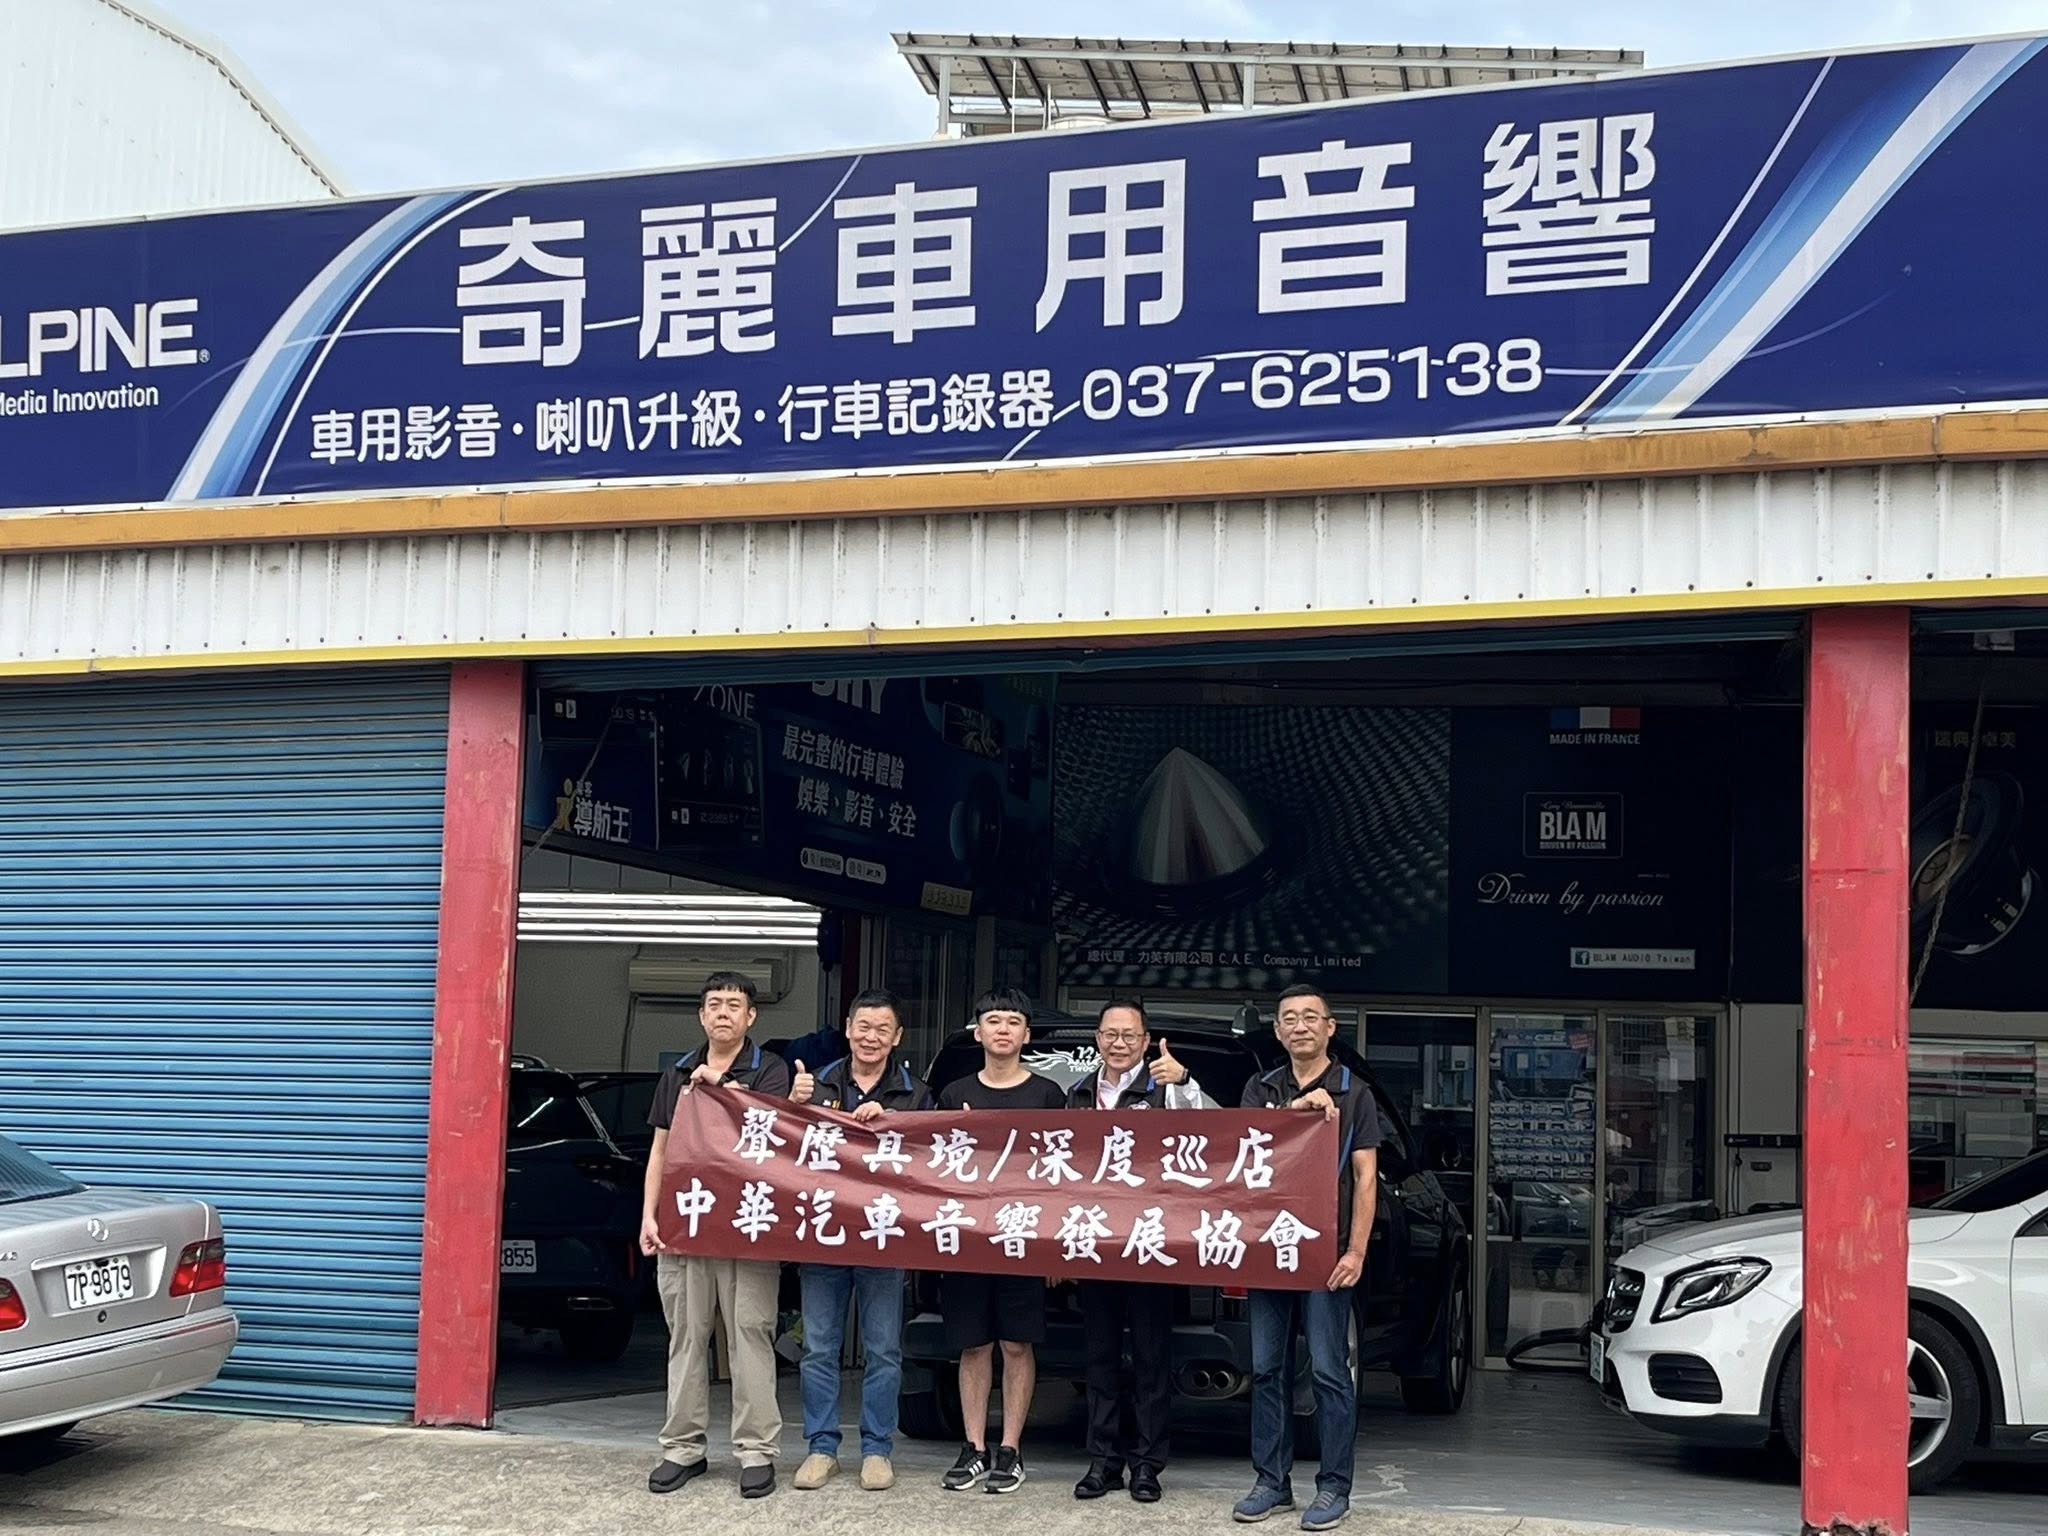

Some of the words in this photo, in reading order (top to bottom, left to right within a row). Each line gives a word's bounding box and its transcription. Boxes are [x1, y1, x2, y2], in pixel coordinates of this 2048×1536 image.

[456, 112, 1657, 367] 奇麗車用音響
[1081, 337, 1543, 421] 037-625138
[0, 389, 47, 416] edia
[53, 383, 159, 413] Innovation
[782, 723, 905, 791] 最完整的行車體驗
[1549, 733, 1581, 745] MADE
[1584, 733, 1597, 745] IN
[1598, 733, 1641, 745] FRANCE
[573, 796, 630, 844] 導航王
[1539, 811, 1607, 841] BLAM
[1477, 872, 1551, 905] Driven
[1558, 880, 1585, 915] by
[1586, 889, 1664, 915] passion
[1263, 952, 1309, 967] Company
[1314, 954, 1361, 967] Limited
[1622, 953, 1651, 962] AUDIO
[675, 1176, 1321, 1273] 中華汽車音響發展協會
[501, 1247, 534, 1267] 855
[67, 1264, 133, 1302] 7P-9879
